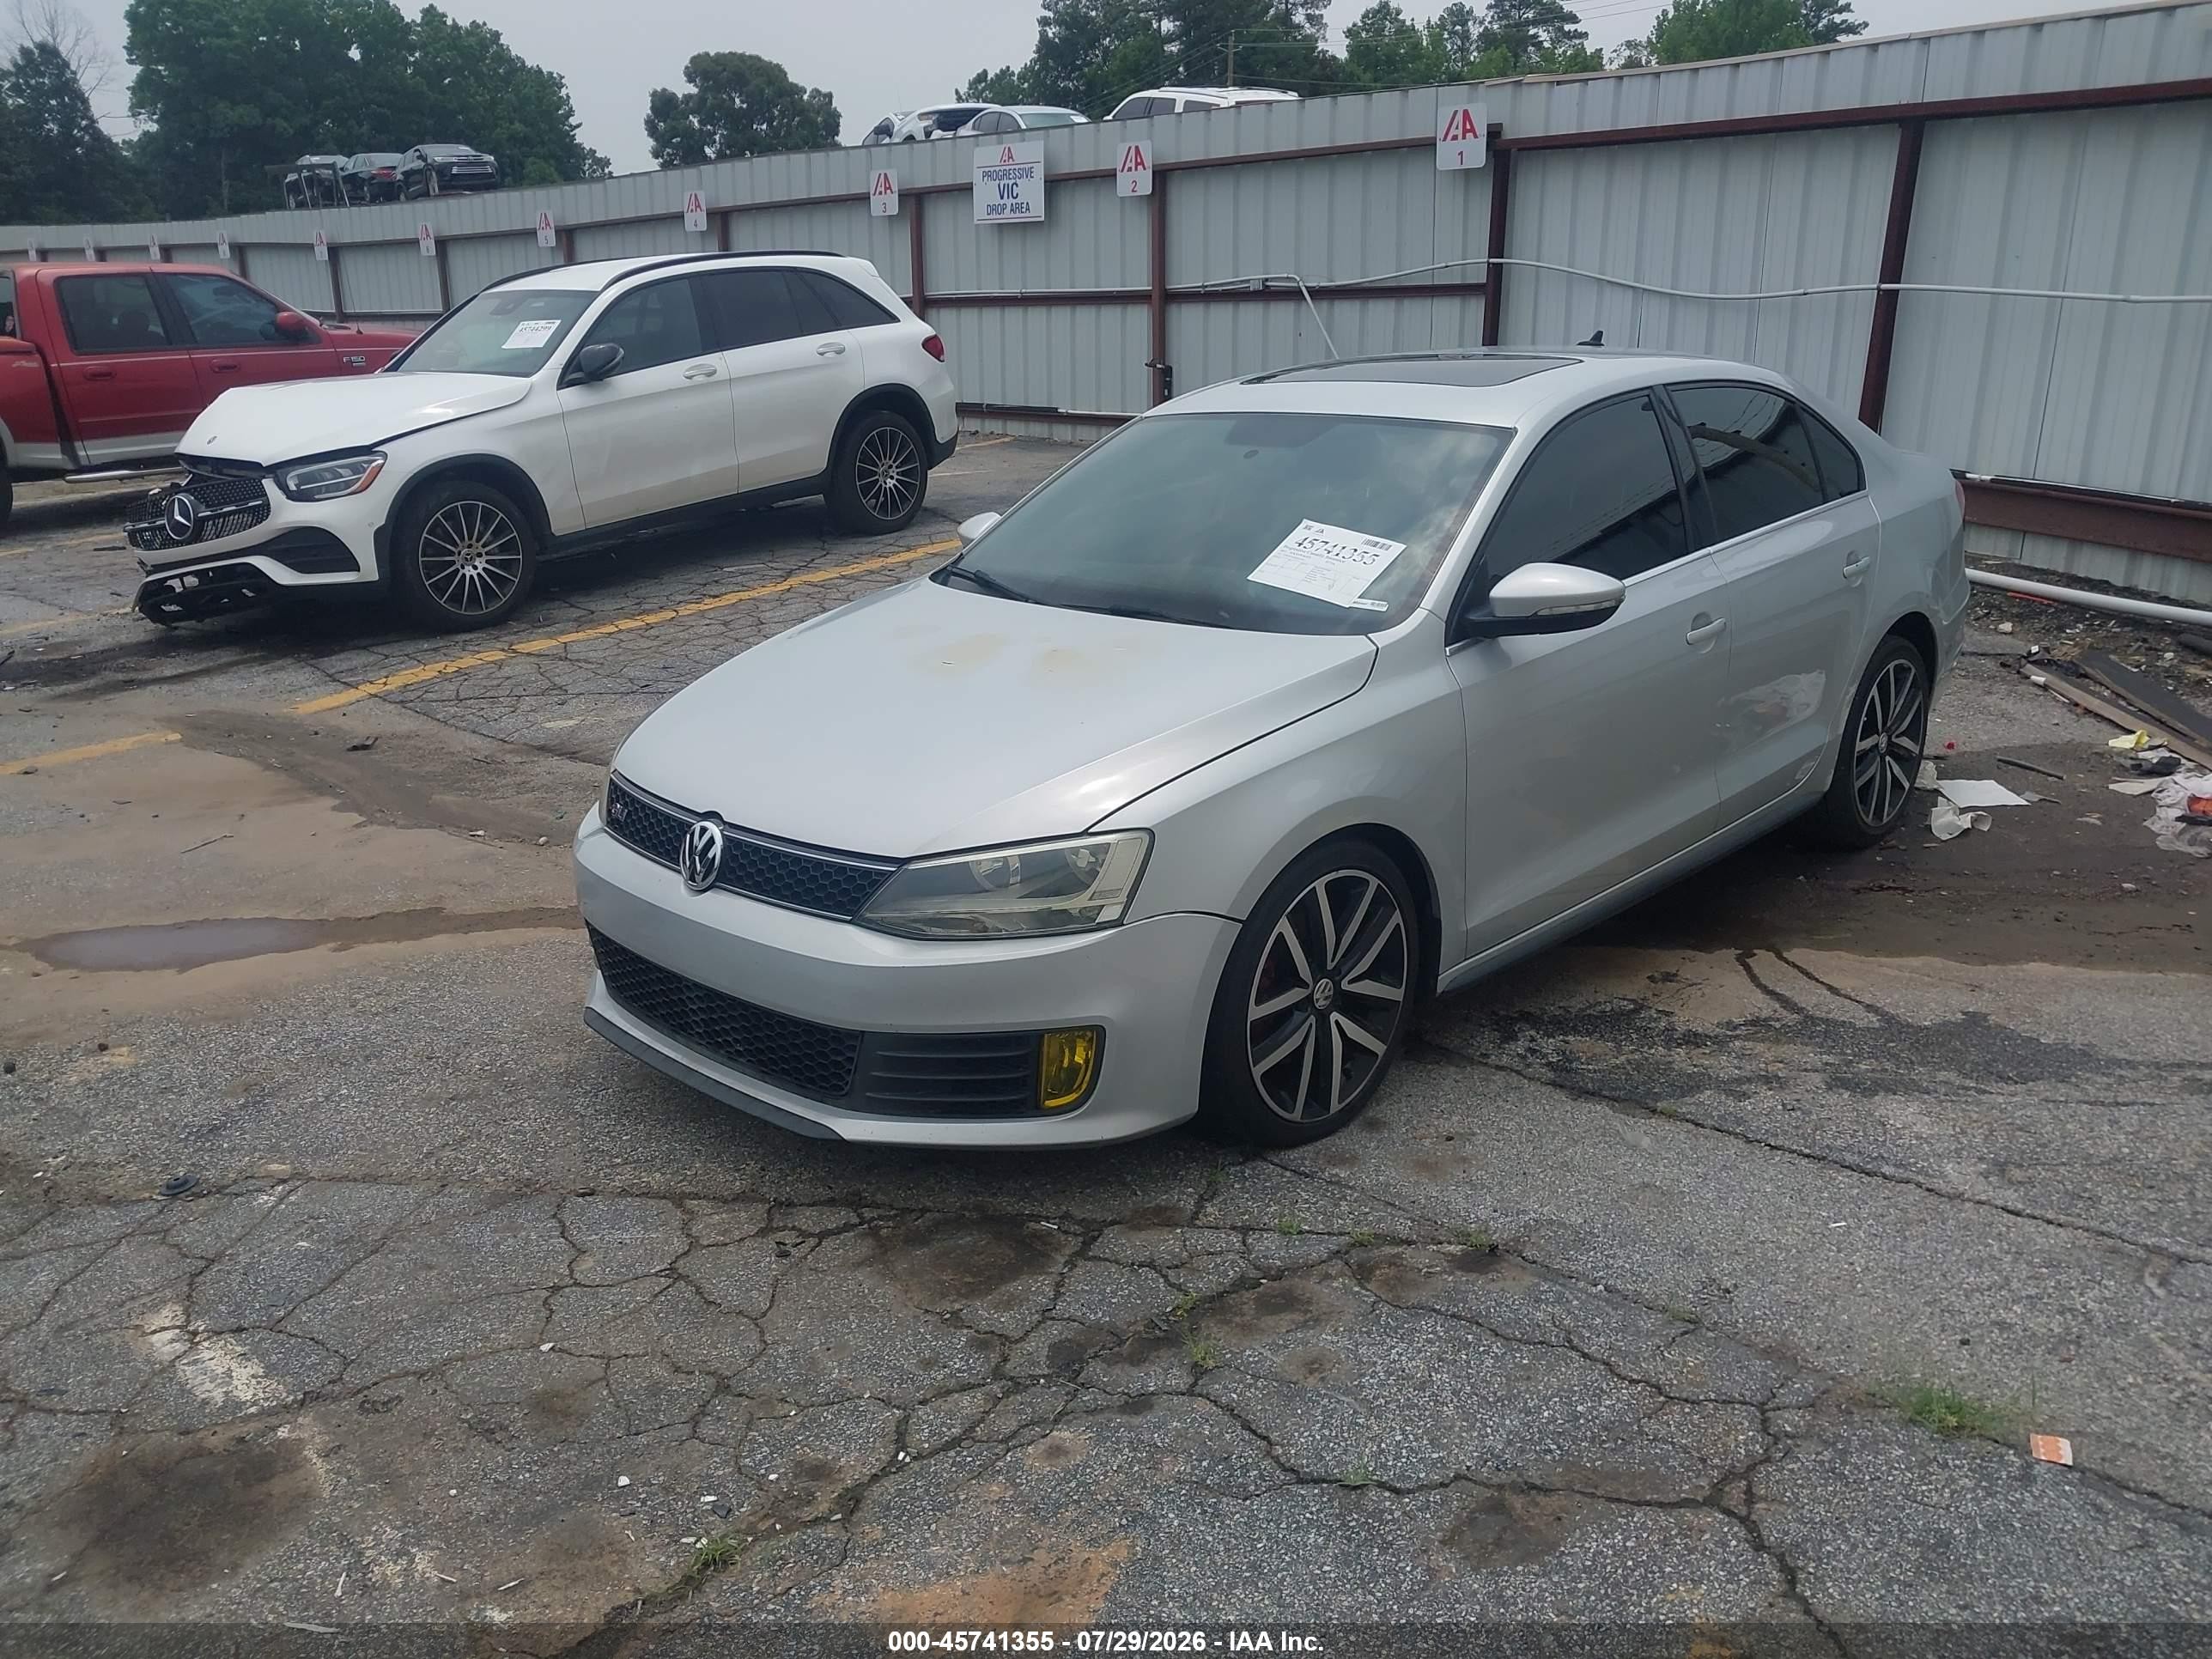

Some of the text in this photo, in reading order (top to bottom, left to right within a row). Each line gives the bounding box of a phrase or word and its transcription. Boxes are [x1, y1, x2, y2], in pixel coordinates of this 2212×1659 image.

[1457, 151, 1464, 166] 1
[981, 167, 1034, 182] PROGRESSIVE
[998, 182, 1019, 200] VIC
[1131, 179, 1138, 193] 2
[881, 202, 887, 214] 3
[986, 202, 1030, 216] DROP AREA
[1295, 536, 1381, 566] 45741355
